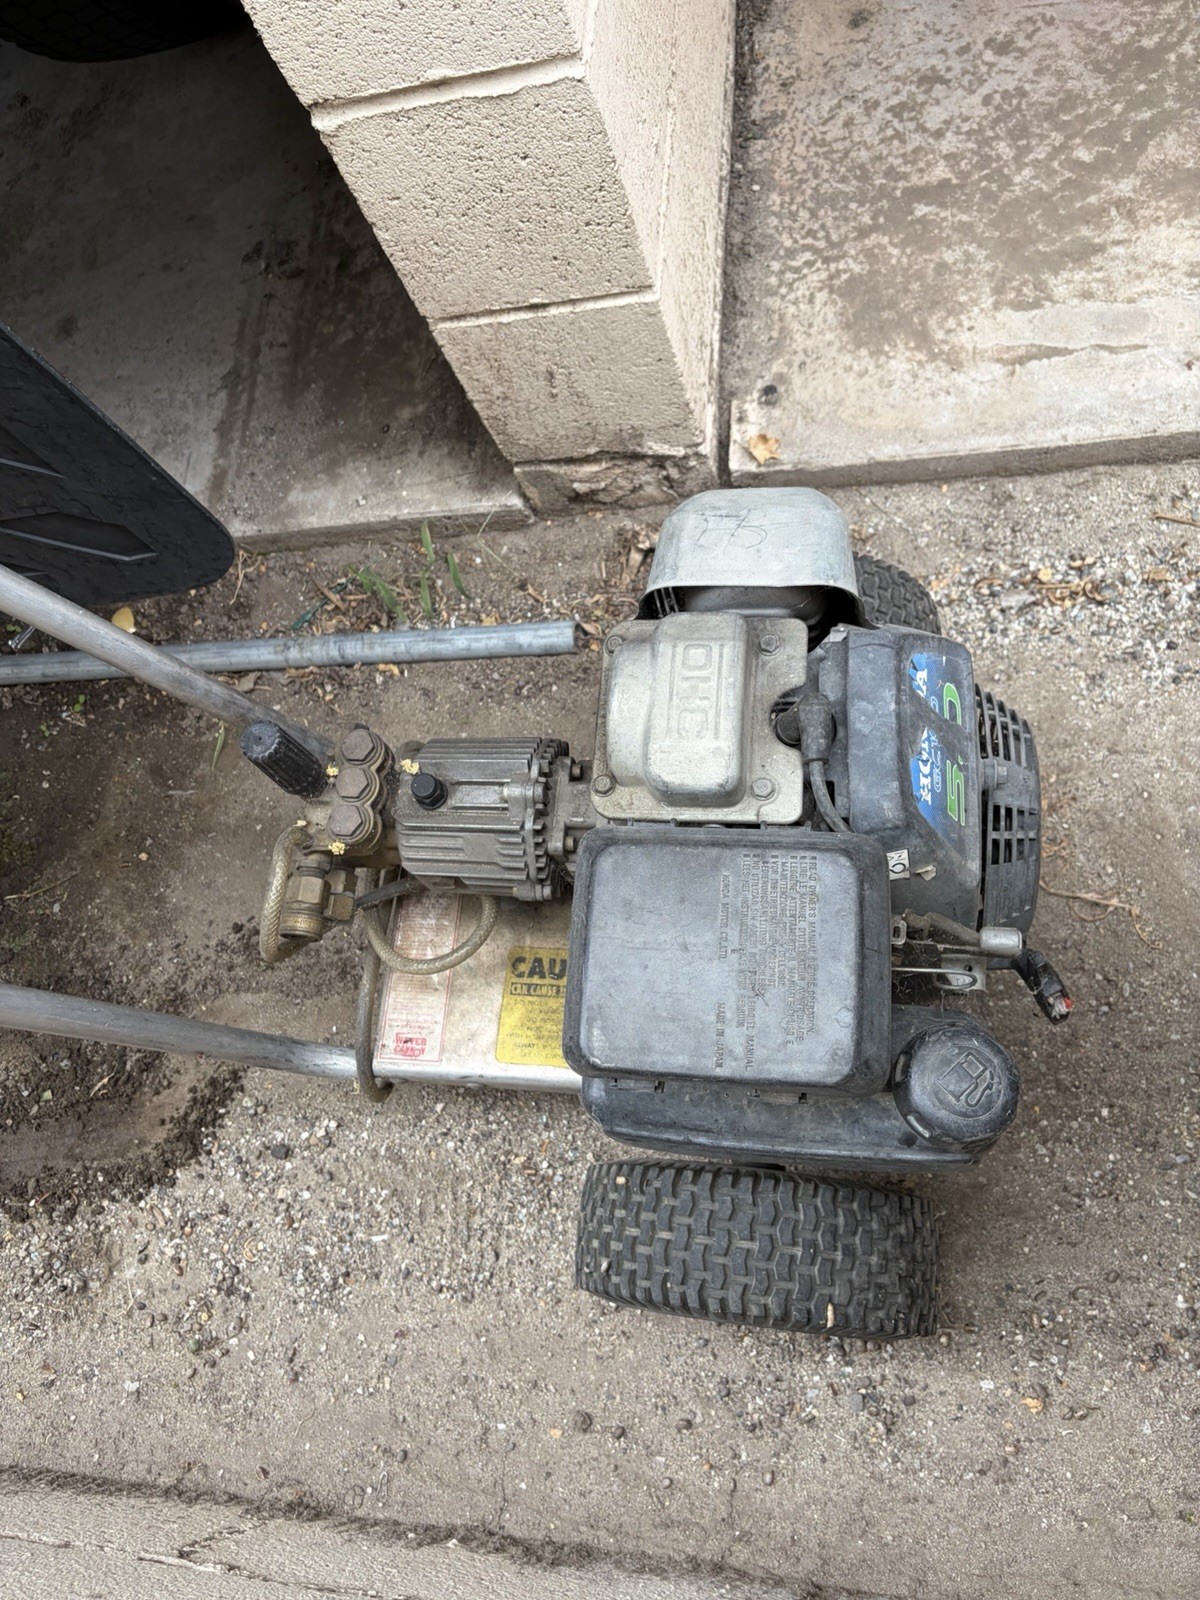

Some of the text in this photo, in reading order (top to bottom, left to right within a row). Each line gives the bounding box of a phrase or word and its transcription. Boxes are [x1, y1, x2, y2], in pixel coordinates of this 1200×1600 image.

[917, 668, 932, 805] HOA
[808, 861, 817, 881] READ
[721, 874, 730, 899] HONDA
[808, 885, 817, 918] OWNER'S
[720, 902, 730, 928] MOTOR
[807, 921, 816, 953] MANUAL
[715, 1001, 725, 1025] MADE
[715, 1028, 725, 1037] IN
